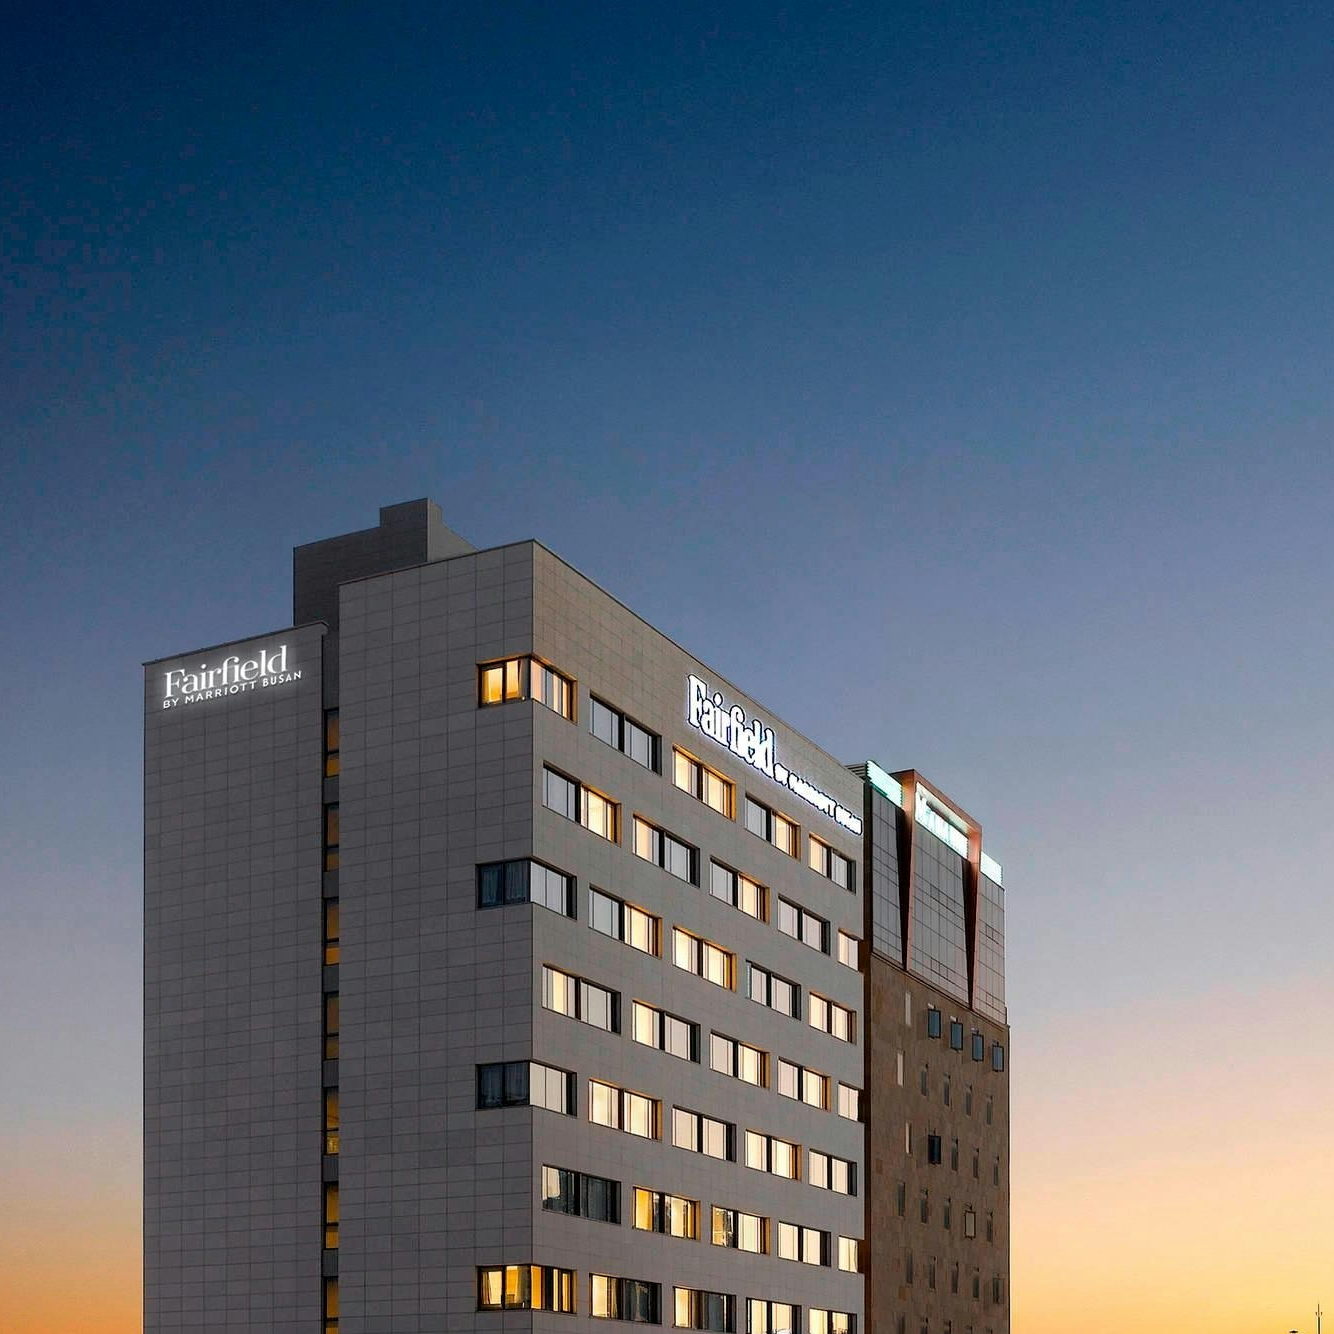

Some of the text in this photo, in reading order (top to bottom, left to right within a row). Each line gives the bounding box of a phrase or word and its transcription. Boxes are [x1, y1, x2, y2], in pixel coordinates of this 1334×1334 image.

[163, 670, 303, 710] BY MARRIOTT BUSAN
[164, 644, 288, 698] Fairfield
[687, 673, 775, 780] Fairfield
